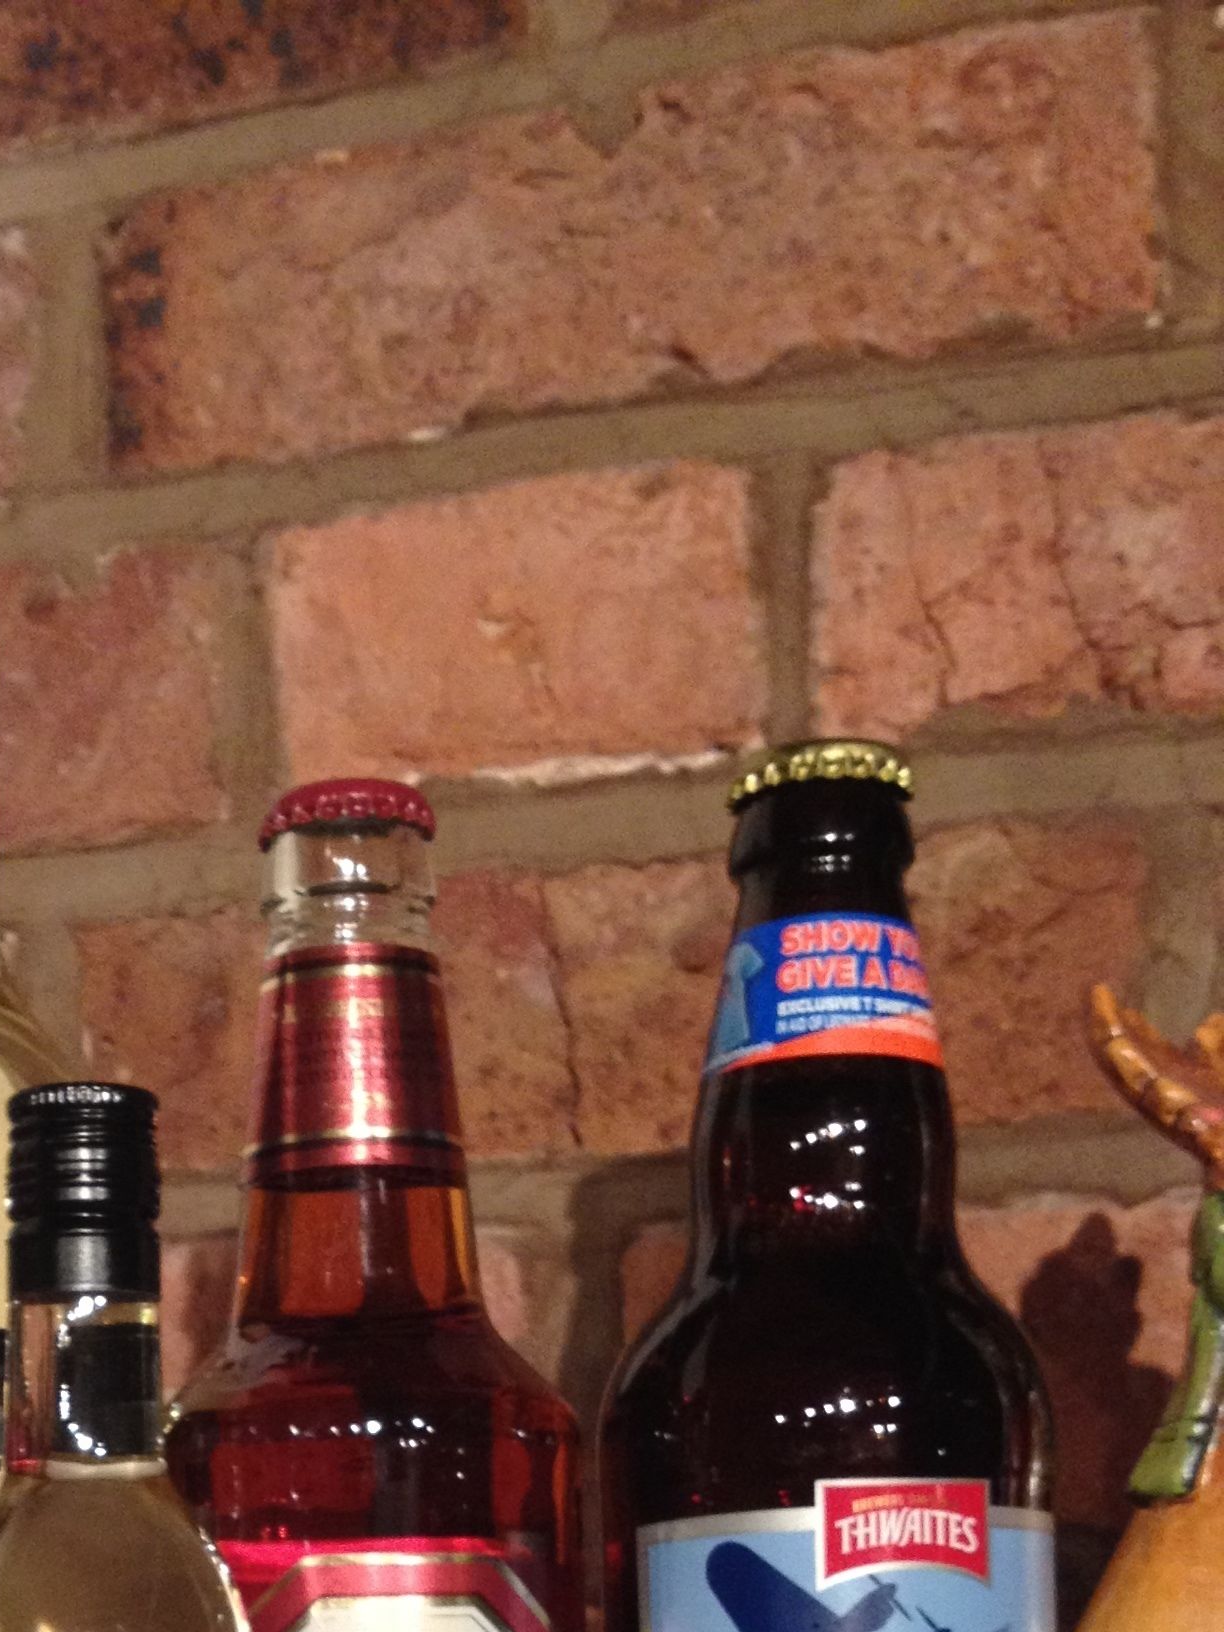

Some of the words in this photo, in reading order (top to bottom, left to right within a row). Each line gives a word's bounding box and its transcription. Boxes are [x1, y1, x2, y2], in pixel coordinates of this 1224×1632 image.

[781, 920, 881, 957] SHOW
[777, 954, 858, 993] GIVE
[862, 956, 887, 989] A
[834, 1507, 980, 1555] THWAITES
